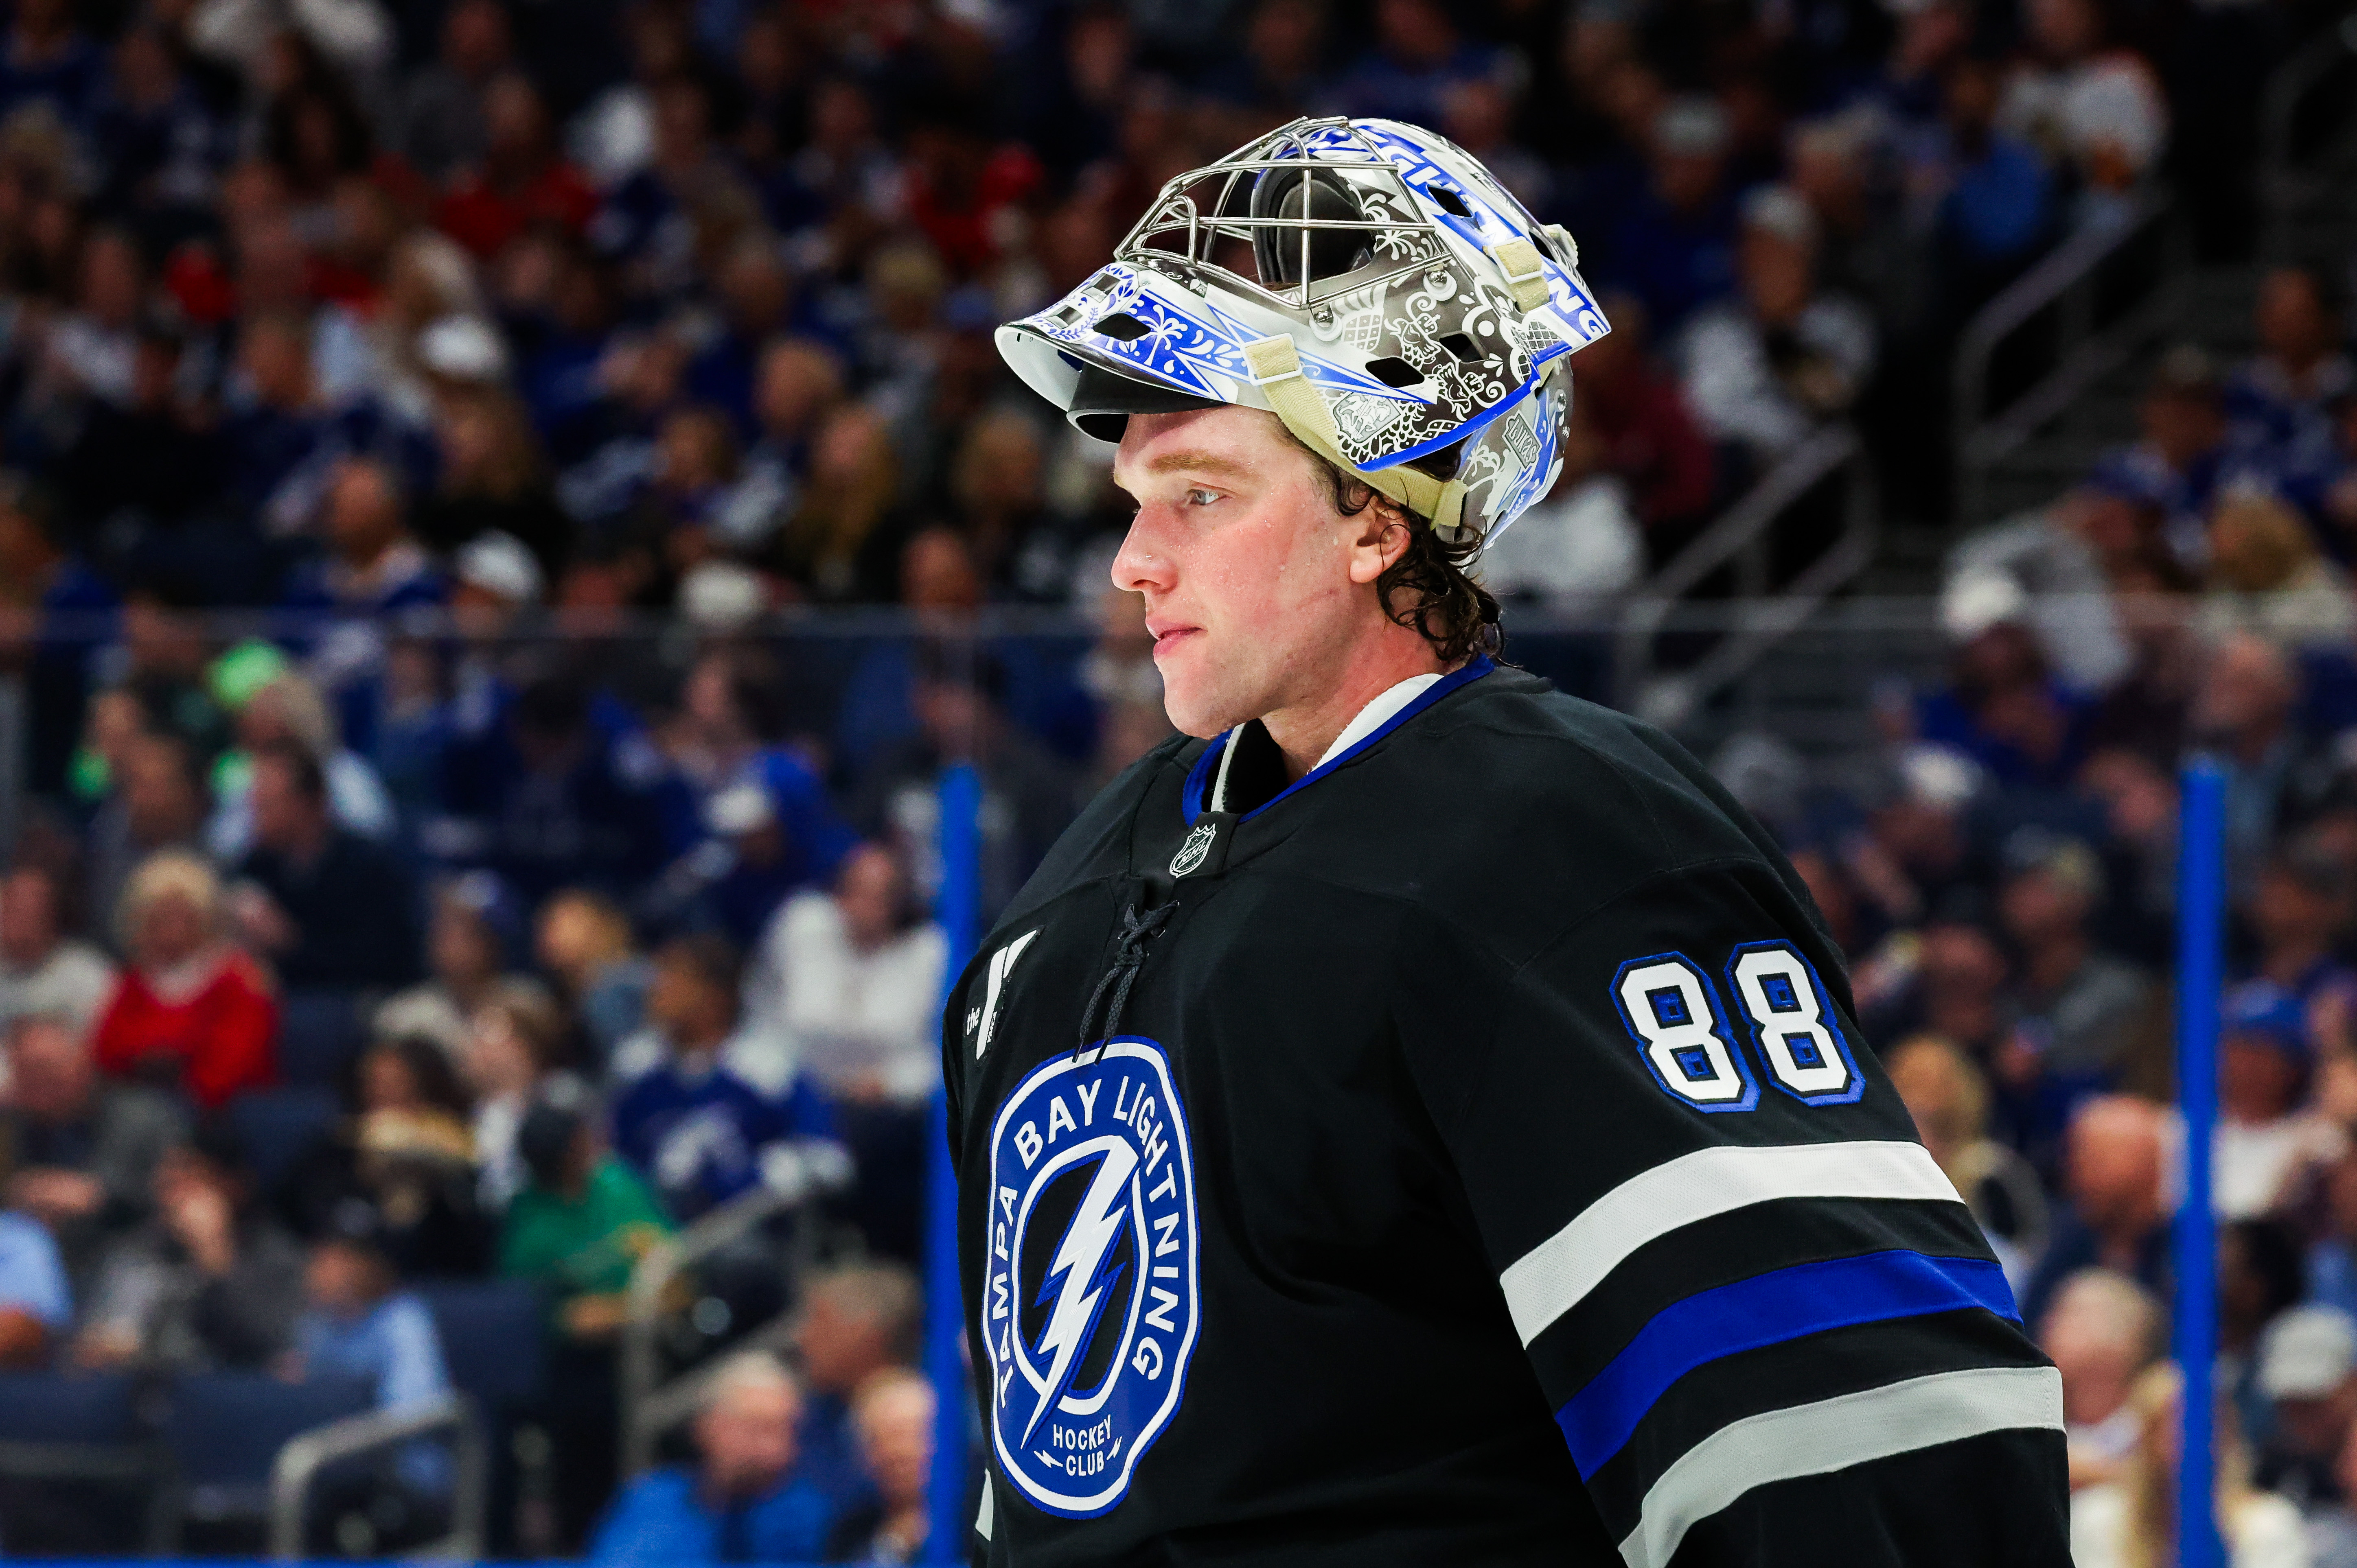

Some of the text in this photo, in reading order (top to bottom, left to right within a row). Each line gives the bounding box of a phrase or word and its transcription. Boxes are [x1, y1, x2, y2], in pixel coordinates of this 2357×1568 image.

[1177, 840, 1206, 866] NHL
[967, 1007, 980, 1035] the
[1611, 940, 1864, 1111] 88
[992, 1075, 1180, 1409] TAMPA BAY LIGHTNING
[1053, 1414, 1111, 1450] HOCKEY
[1066, 1450, 1104, 1476] CLUB
